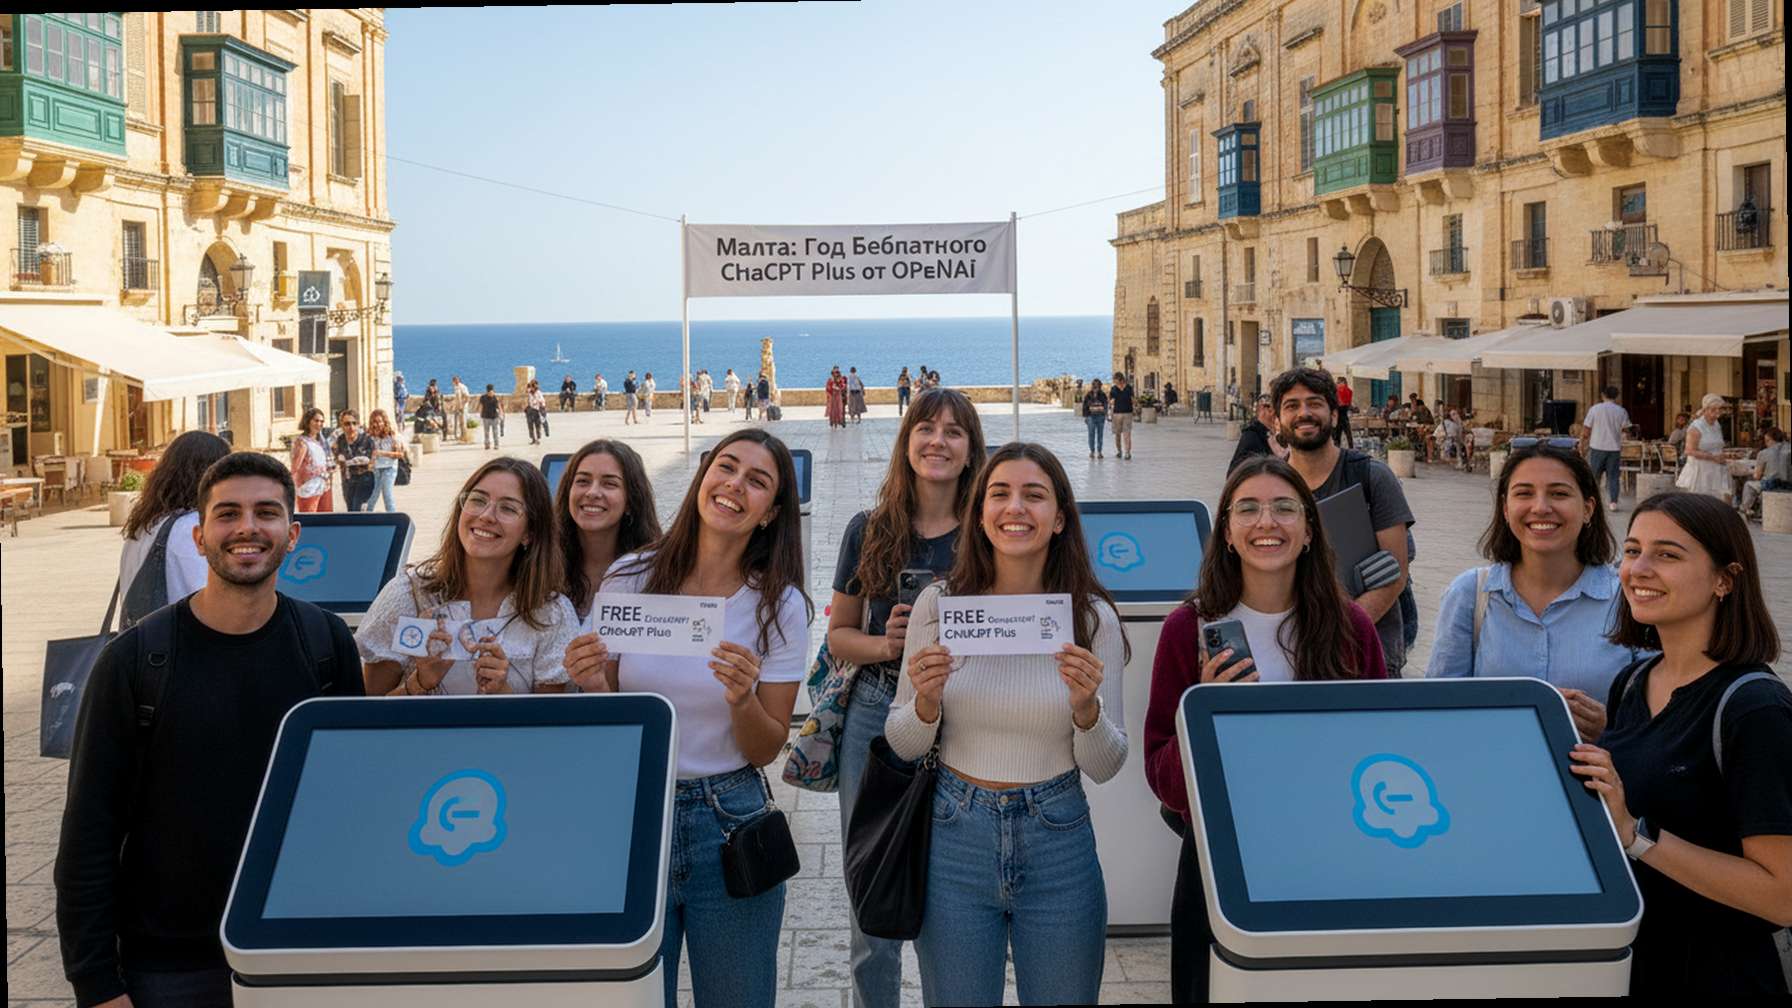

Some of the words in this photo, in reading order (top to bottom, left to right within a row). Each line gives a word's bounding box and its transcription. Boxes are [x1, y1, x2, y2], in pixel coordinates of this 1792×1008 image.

[717, 238, 796, 256] Малта:
[805, 238, 846, 259] Год
[812, 261, 855, 281] Plus
[600, 605, 642, 622] FREE
[943, 609, 985, 624] FREE
[994, 627, 1017, 638] Plus
